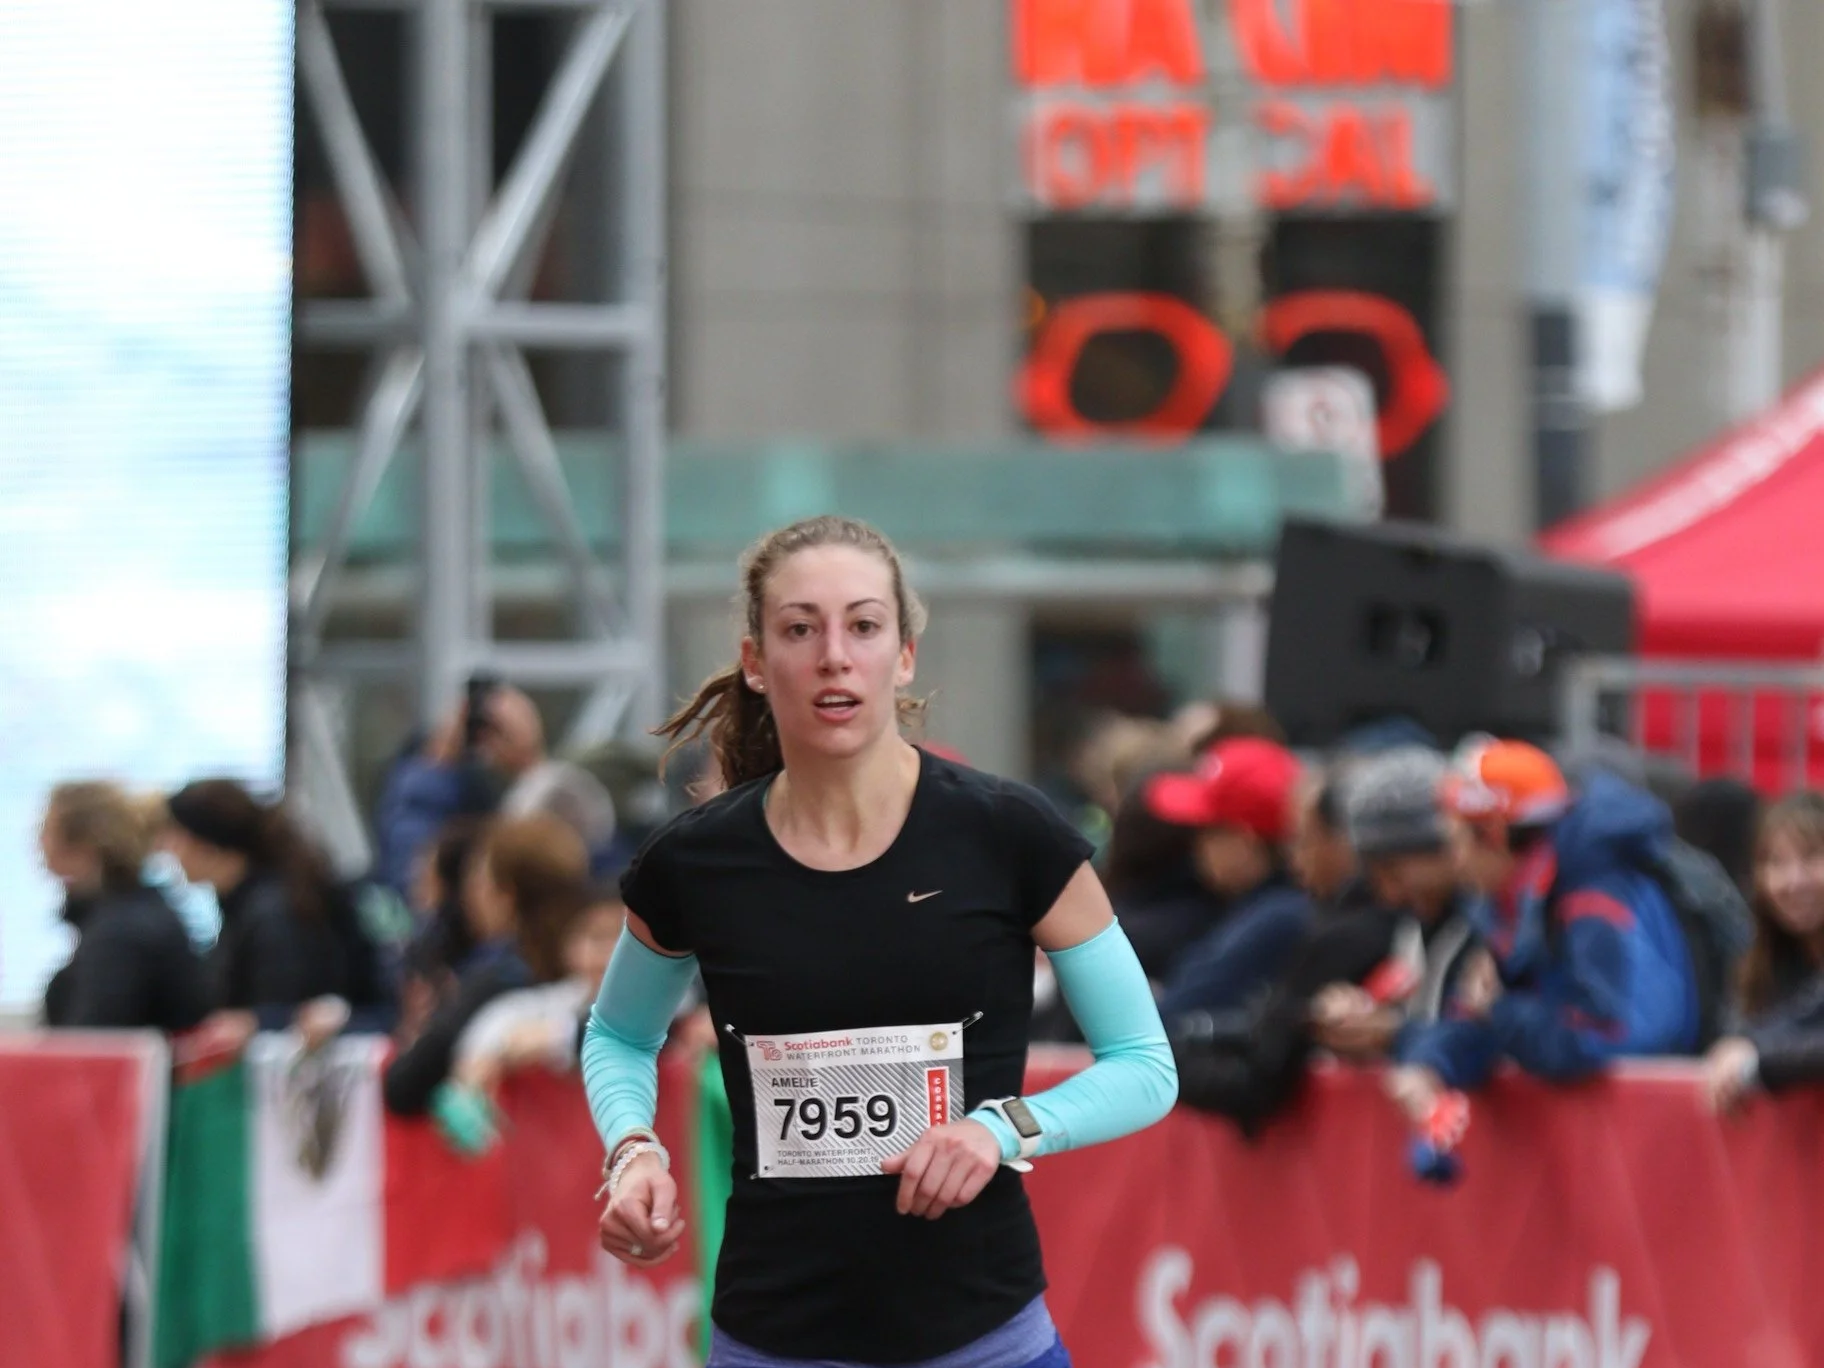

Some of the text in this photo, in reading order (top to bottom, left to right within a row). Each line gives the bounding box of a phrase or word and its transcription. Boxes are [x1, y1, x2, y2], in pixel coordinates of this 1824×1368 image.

[784, 1035, 908, 1051] Scotiabank TORONTO
[786, 1045, 921, 1060] WATERFRONT MARATHON
[772, 1077, 819, 1088] AMELIE
[774, 1094, 897, 1141] 7959
[777, 1150, 812, 1158] TORONTO
